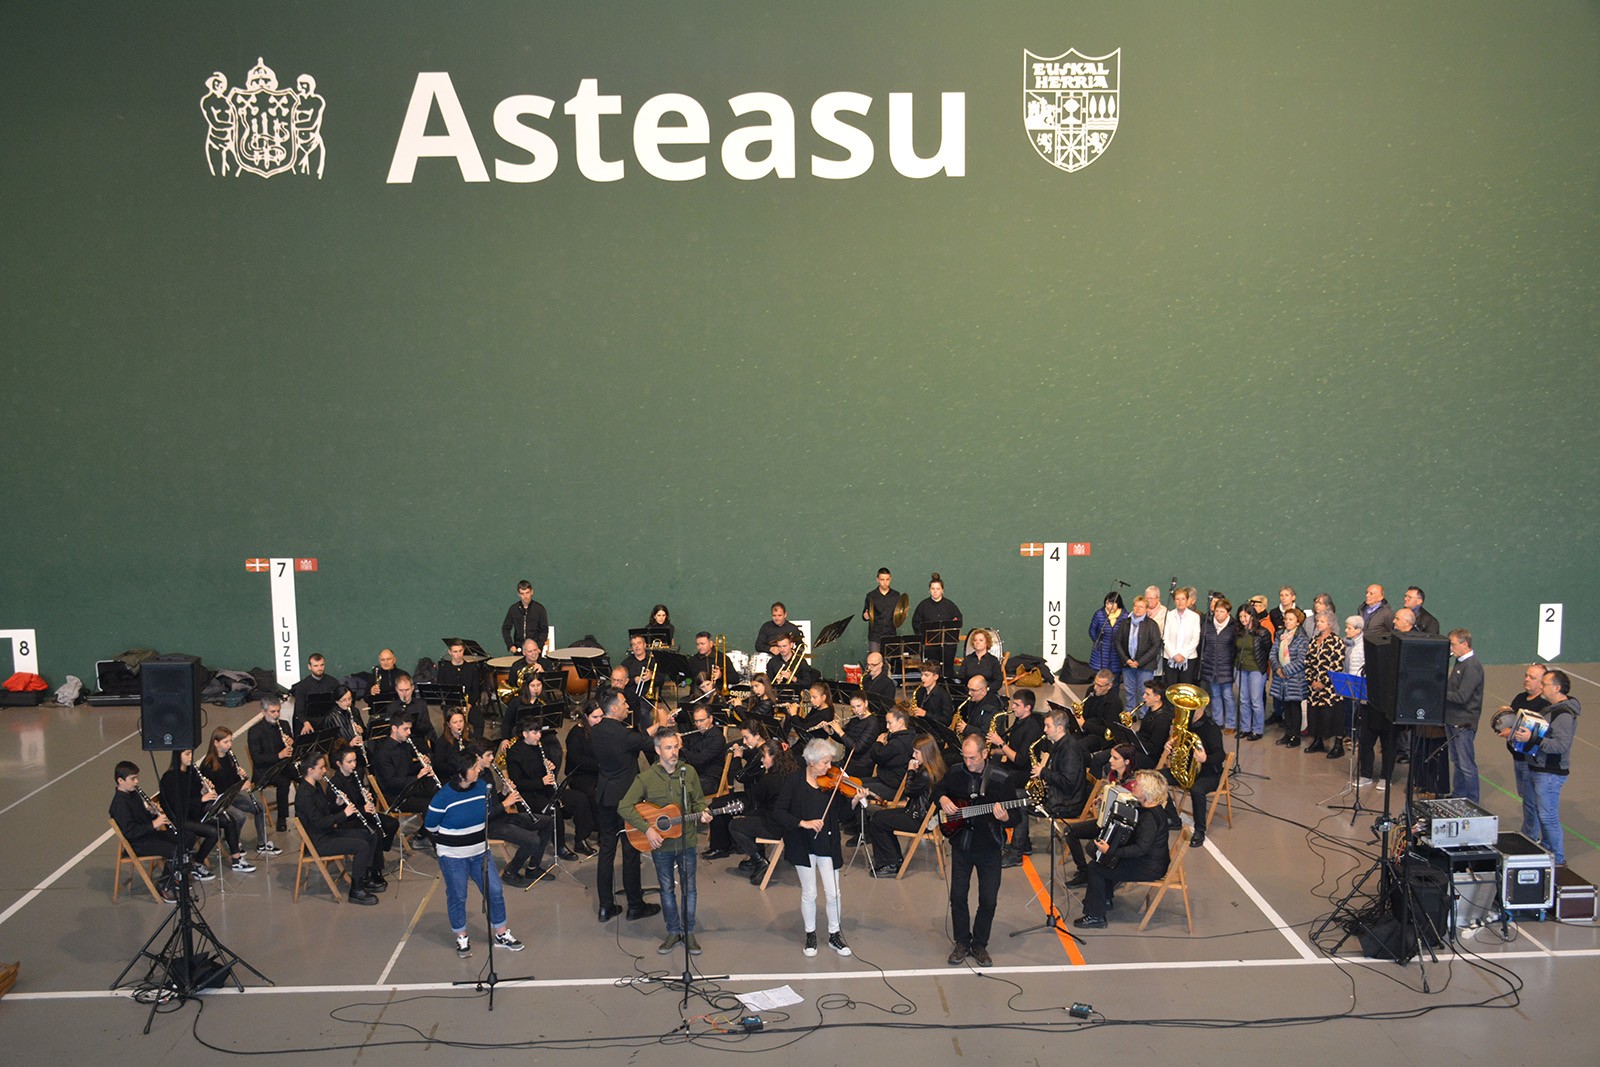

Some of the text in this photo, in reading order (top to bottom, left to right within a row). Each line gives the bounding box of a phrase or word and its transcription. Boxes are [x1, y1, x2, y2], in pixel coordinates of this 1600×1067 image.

[1032, 62, 1110, 76] EUSKAL
[1034, 75, 1109, 89] HERRIA
[386, 71, 966, 184] Asteasu
[1049, 546, 1061, 562] 4
[276, 562, 287, 578] 7
[1545, 607, 1556, 623] 2
[1048, 600, 1062, 655] MOTZ
[19, 640, 30, 657] 8
[281, 617, 292, 672] LUZE
